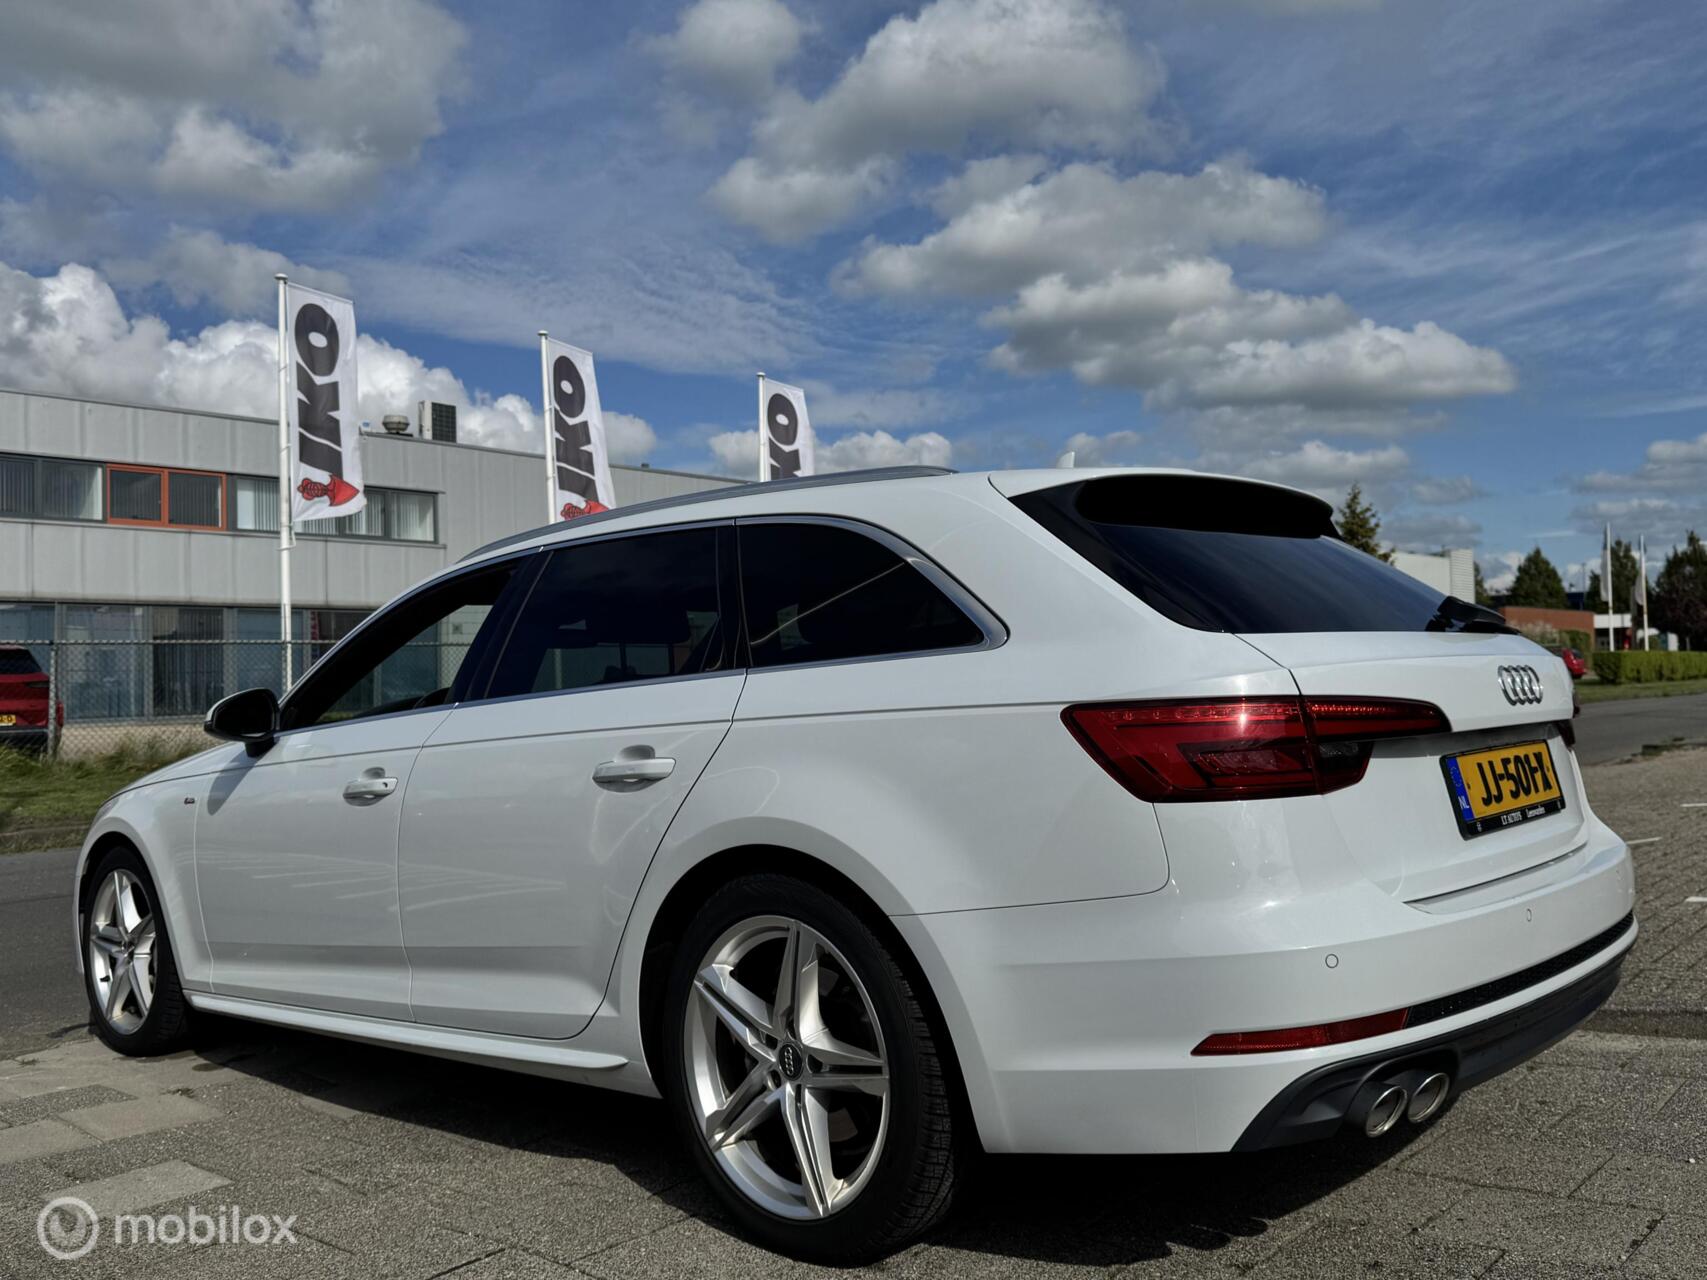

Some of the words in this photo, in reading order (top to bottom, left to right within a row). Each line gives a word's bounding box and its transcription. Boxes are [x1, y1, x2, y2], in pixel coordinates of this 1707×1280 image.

[294, 303, 344, 481] IKO
[553, 355, 600, 502] IKO
[767, 392, 802, 480] KO
[1458, 795, 1470, 810] NL
